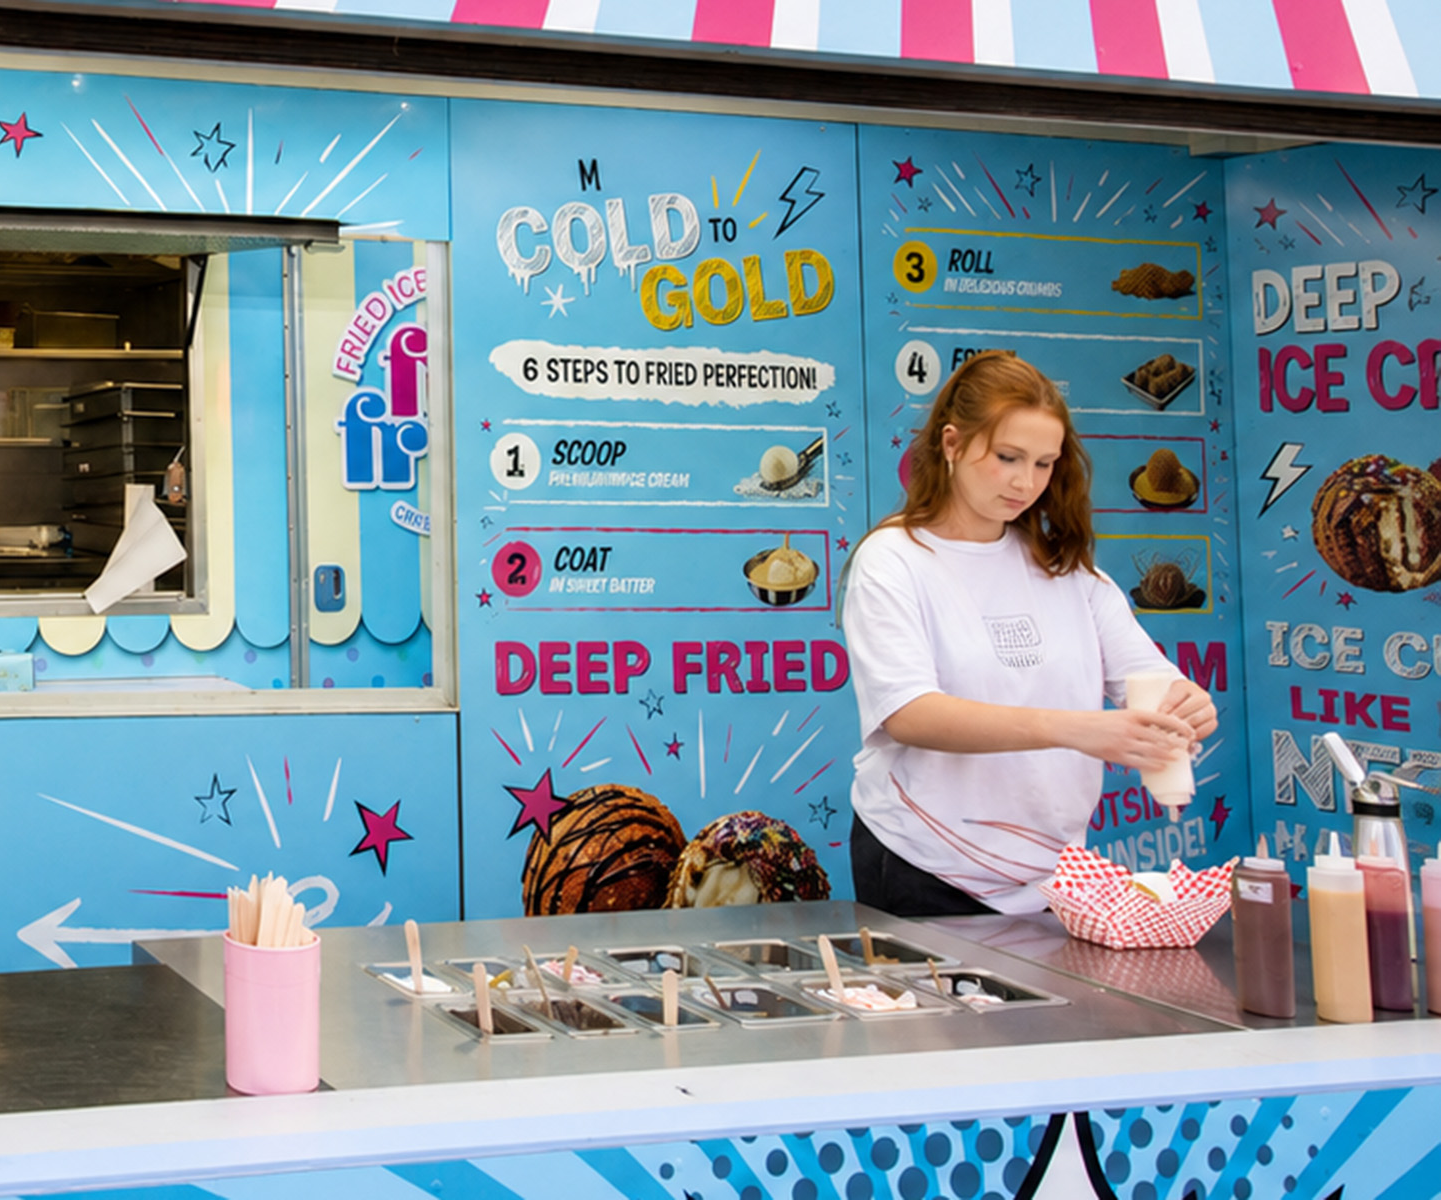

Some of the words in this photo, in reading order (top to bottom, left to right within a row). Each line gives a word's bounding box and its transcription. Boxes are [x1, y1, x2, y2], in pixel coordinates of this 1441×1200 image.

[496, 193, 701, 285] COLD
[709, 217, 737, 243] TO
[640, 249, 835, 331] GOLD
[905, 252, 925, 284] 3
[948, 248, 994, 274] ROLL
[1252, 260, 1401, 336] DEEP
[336, 297, 388, 375] FRIED
[522, 357, 539, 383] 6
[546, 358, 609, 384] STEPS
[614, 360, 640, 385] TO
[645, 360, 697, 386] FRIED
[703, 364, 817, 389] PERFECTION!
[907, 352, 927, 384] 4
[1258, 343, 1349, 413] ICE
[506, 445, 526, 478] 1
[552, 439, 626, 467] SCOOP
[506, 552, 527, 586] 2
[553, 547, 612, 572] COAT
[495, 641, 651, 695] DEEP
[672, 640, 850, 694] FRIED
[1265, 621, 1365, 674] ICE
[1290, 685, 1411, 732] LIKE
